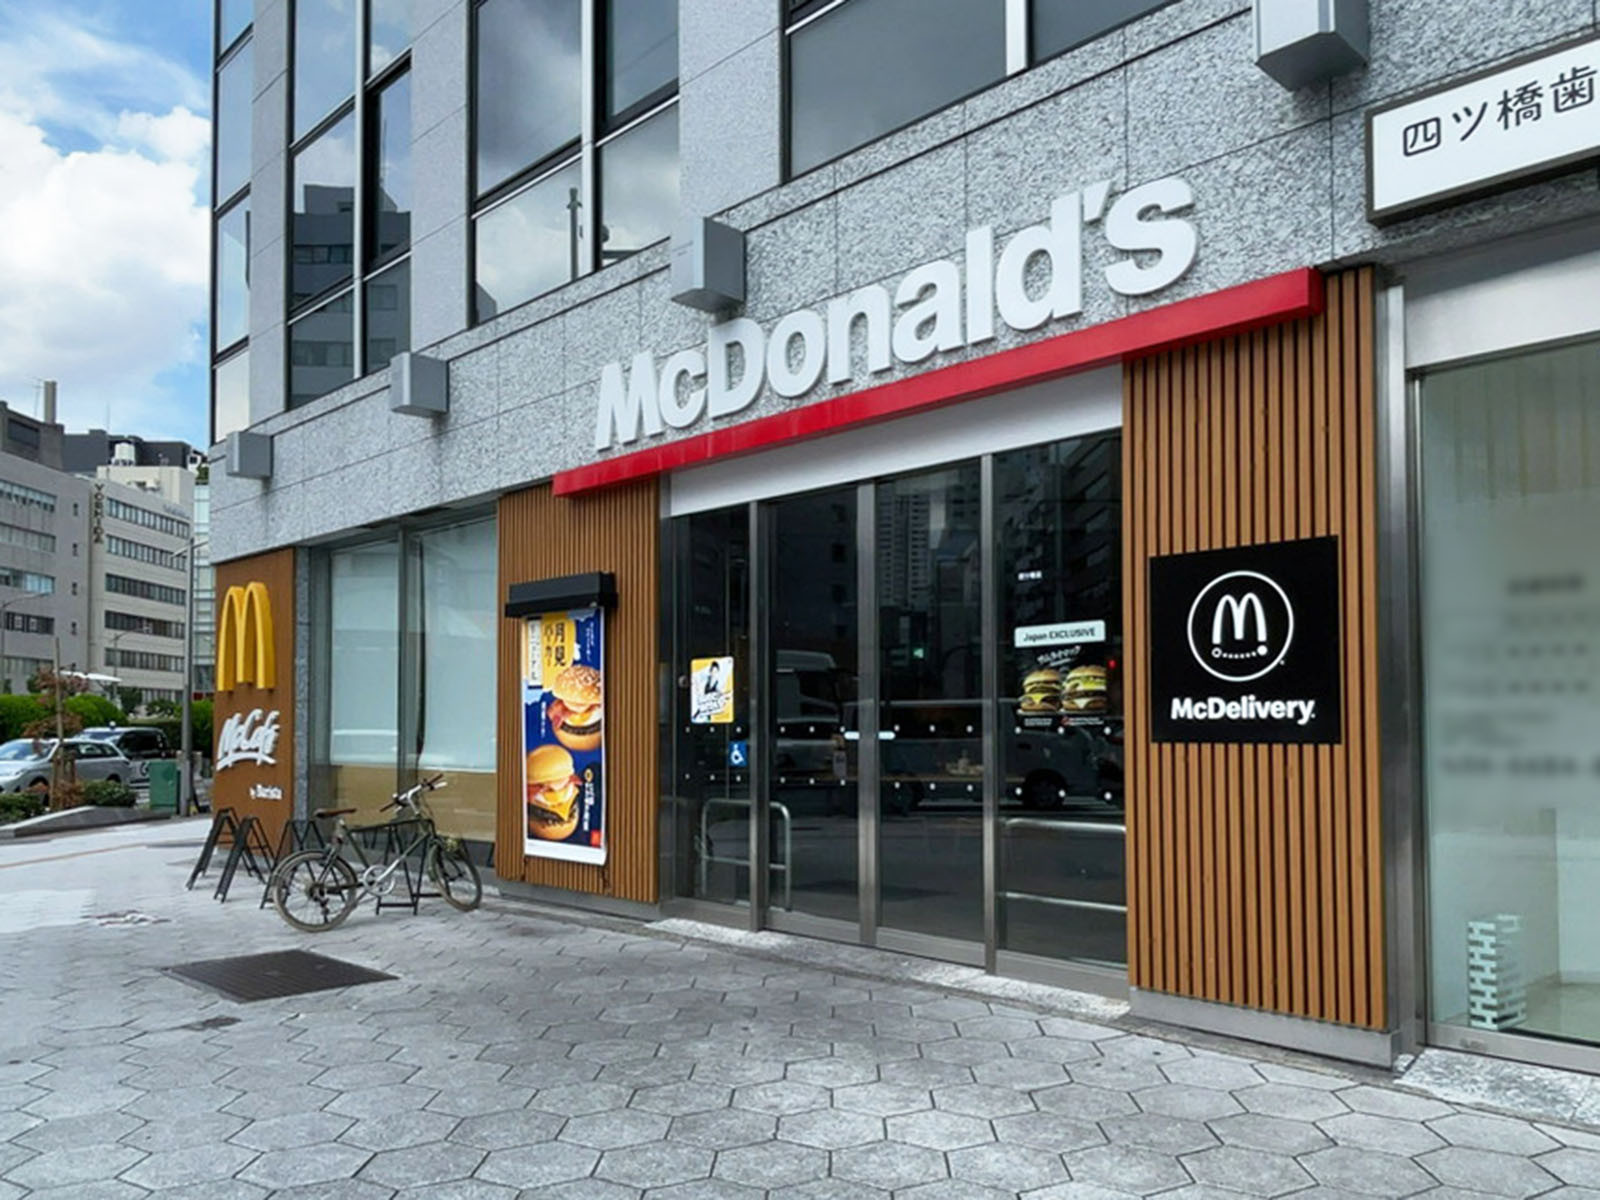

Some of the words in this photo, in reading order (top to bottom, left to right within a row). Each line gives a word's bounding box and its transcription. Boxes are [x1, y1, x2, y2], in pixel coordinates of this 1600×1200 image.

[1402, 65, 1598, 157] 四ツ橋歯
[596, 176, 1198, 452] McDonald's
[1171, 694, 1315, 725] McDelivery
